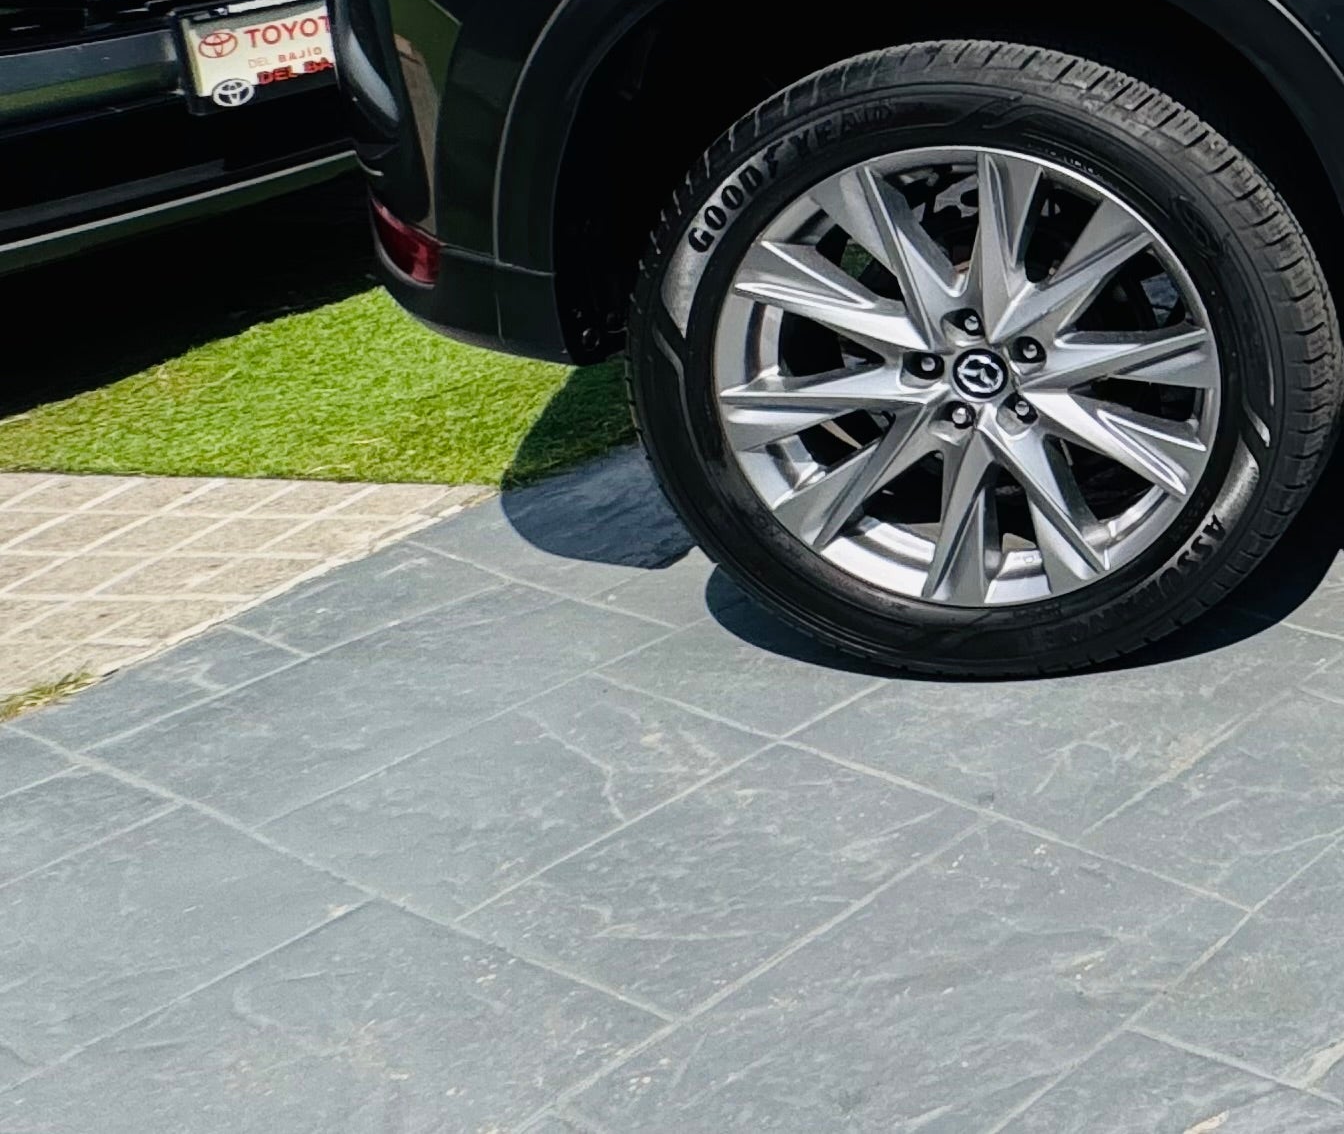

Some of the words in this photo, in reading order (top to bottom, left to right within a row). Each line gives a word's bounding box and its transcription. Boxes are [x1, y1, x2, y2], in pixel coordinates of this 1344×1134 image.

[243, 15, 331, 49] TOYOT
[248, 57, 271, 69] DEL
[257, 65, 298, 85] DEL
